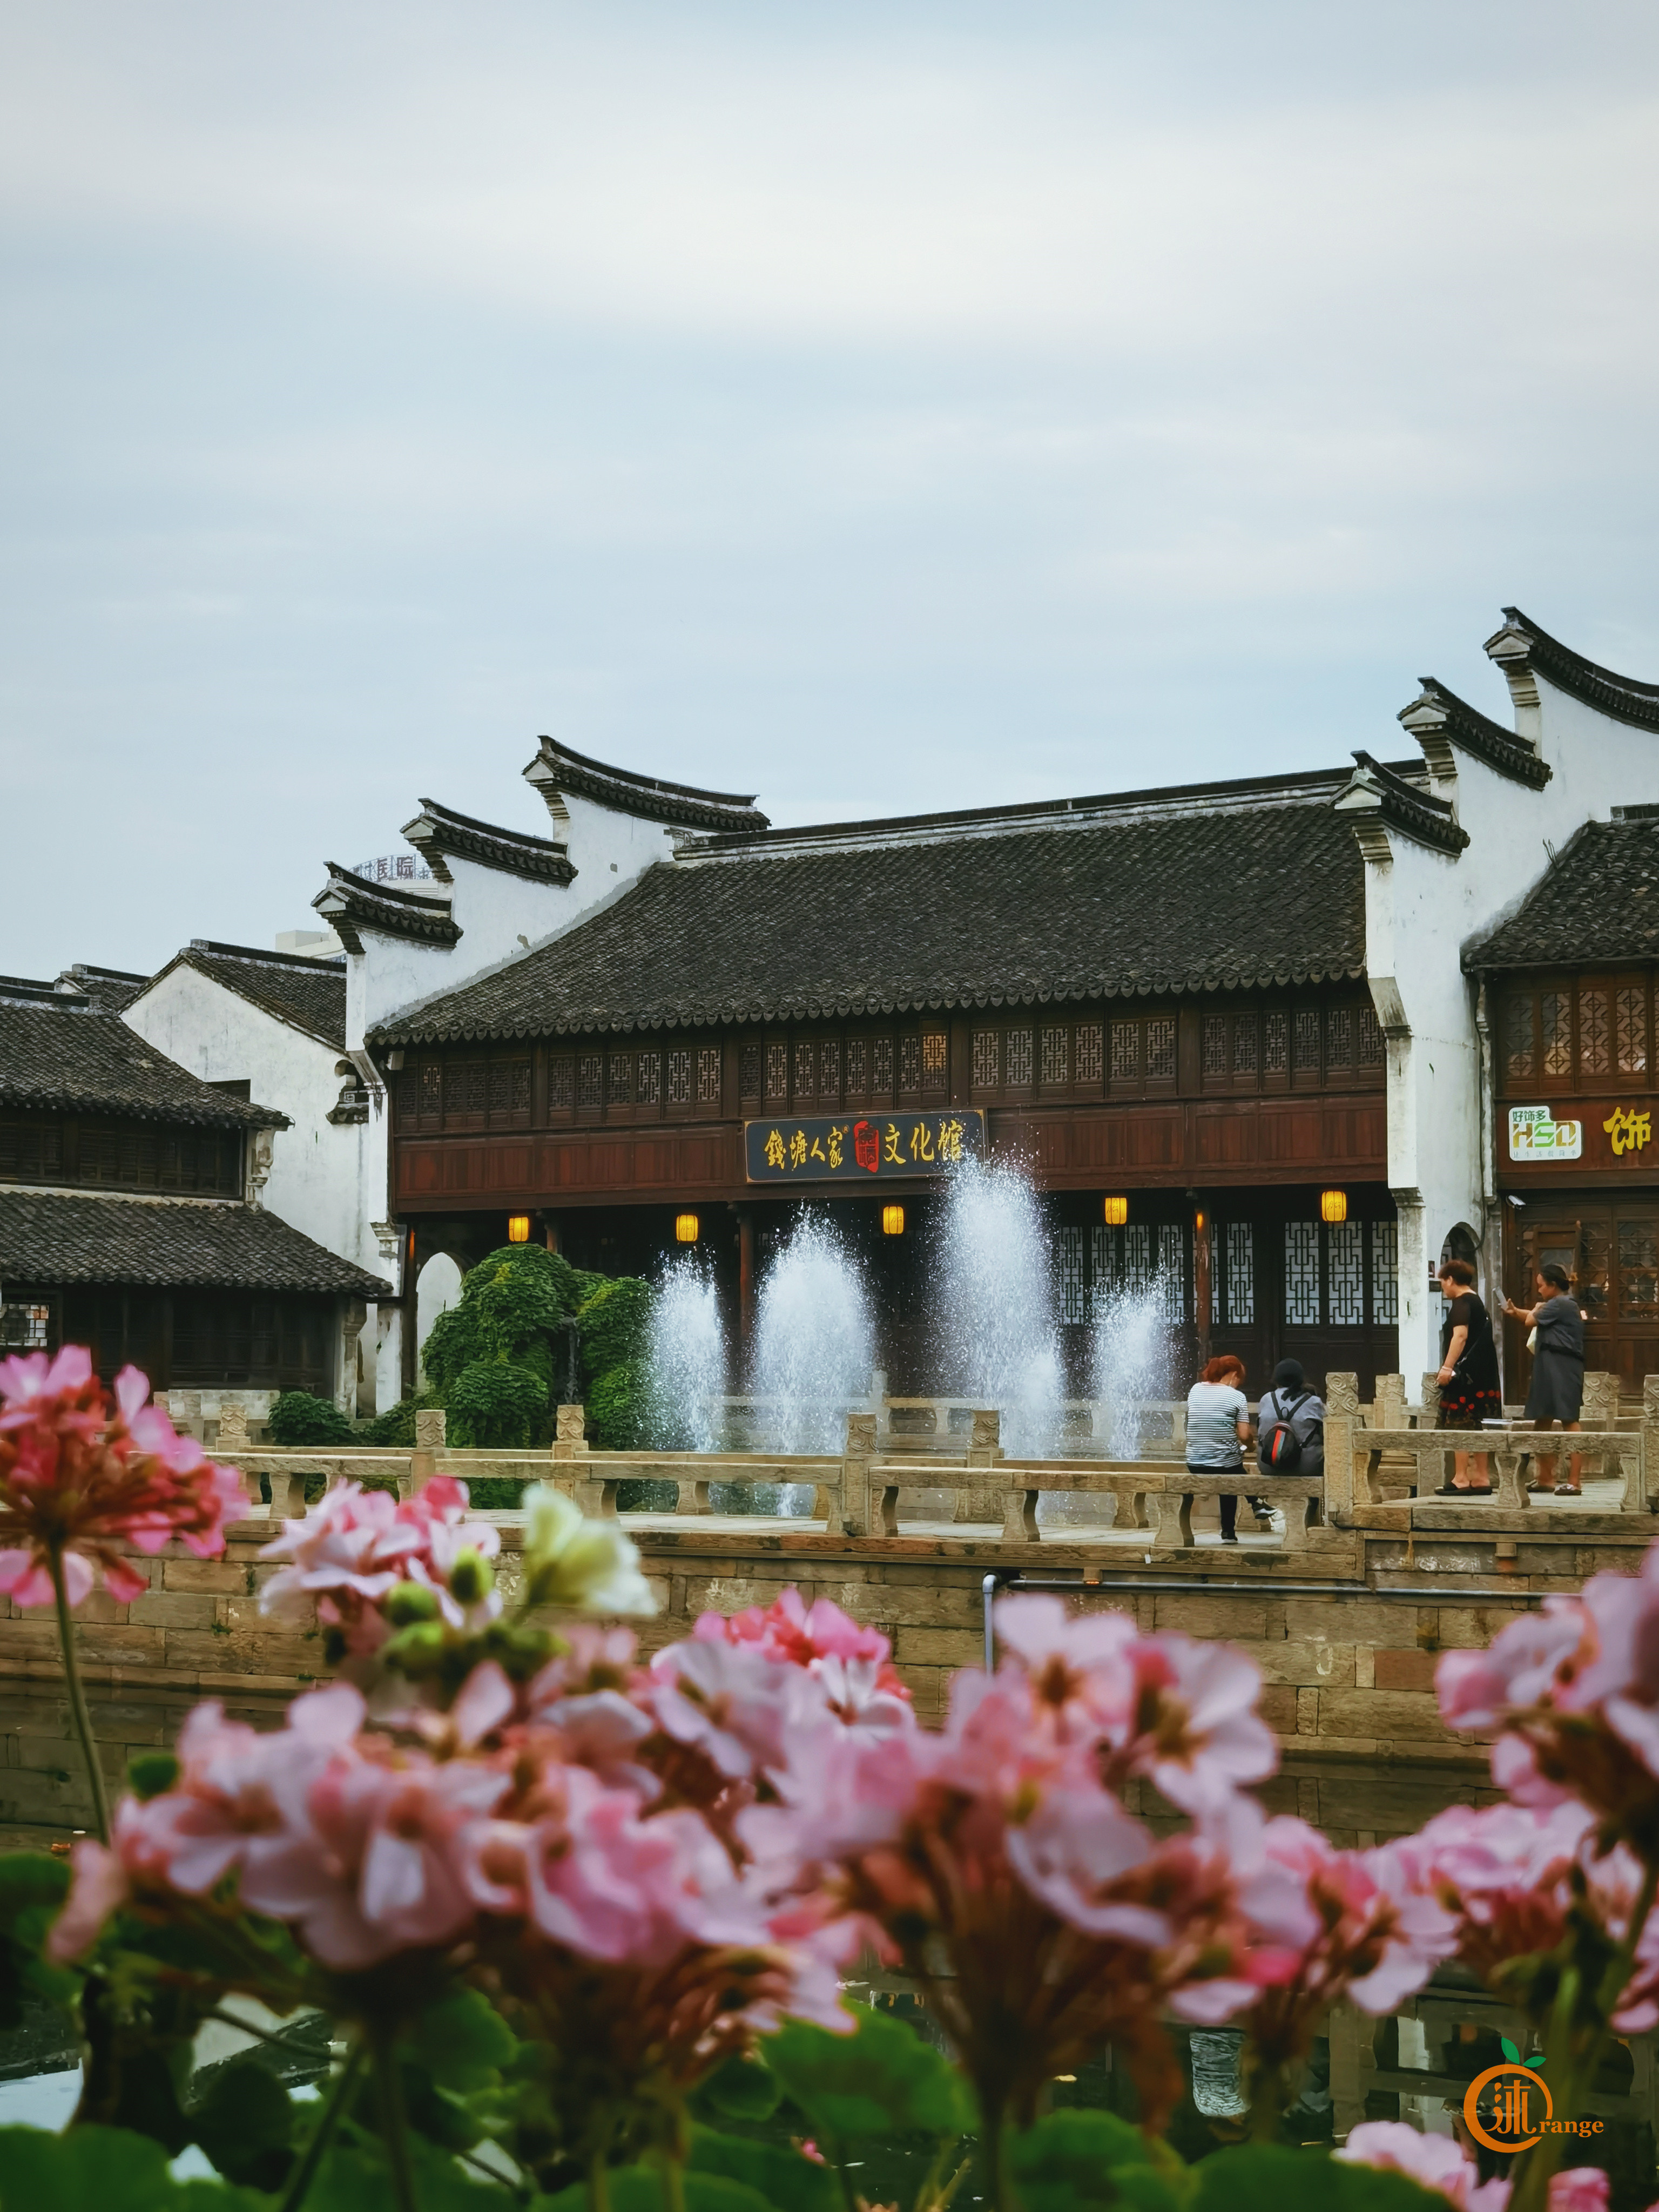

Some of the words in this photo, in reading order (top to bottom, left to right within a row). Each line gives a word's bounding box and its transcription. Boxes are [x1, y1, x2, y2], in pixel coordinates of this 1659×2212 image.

[1512, 1110, 1546, 1122] 好饰多
[1513, 1122, 1576, 1148] HSD
[1603, 1107, 1651, 1155] 饰
